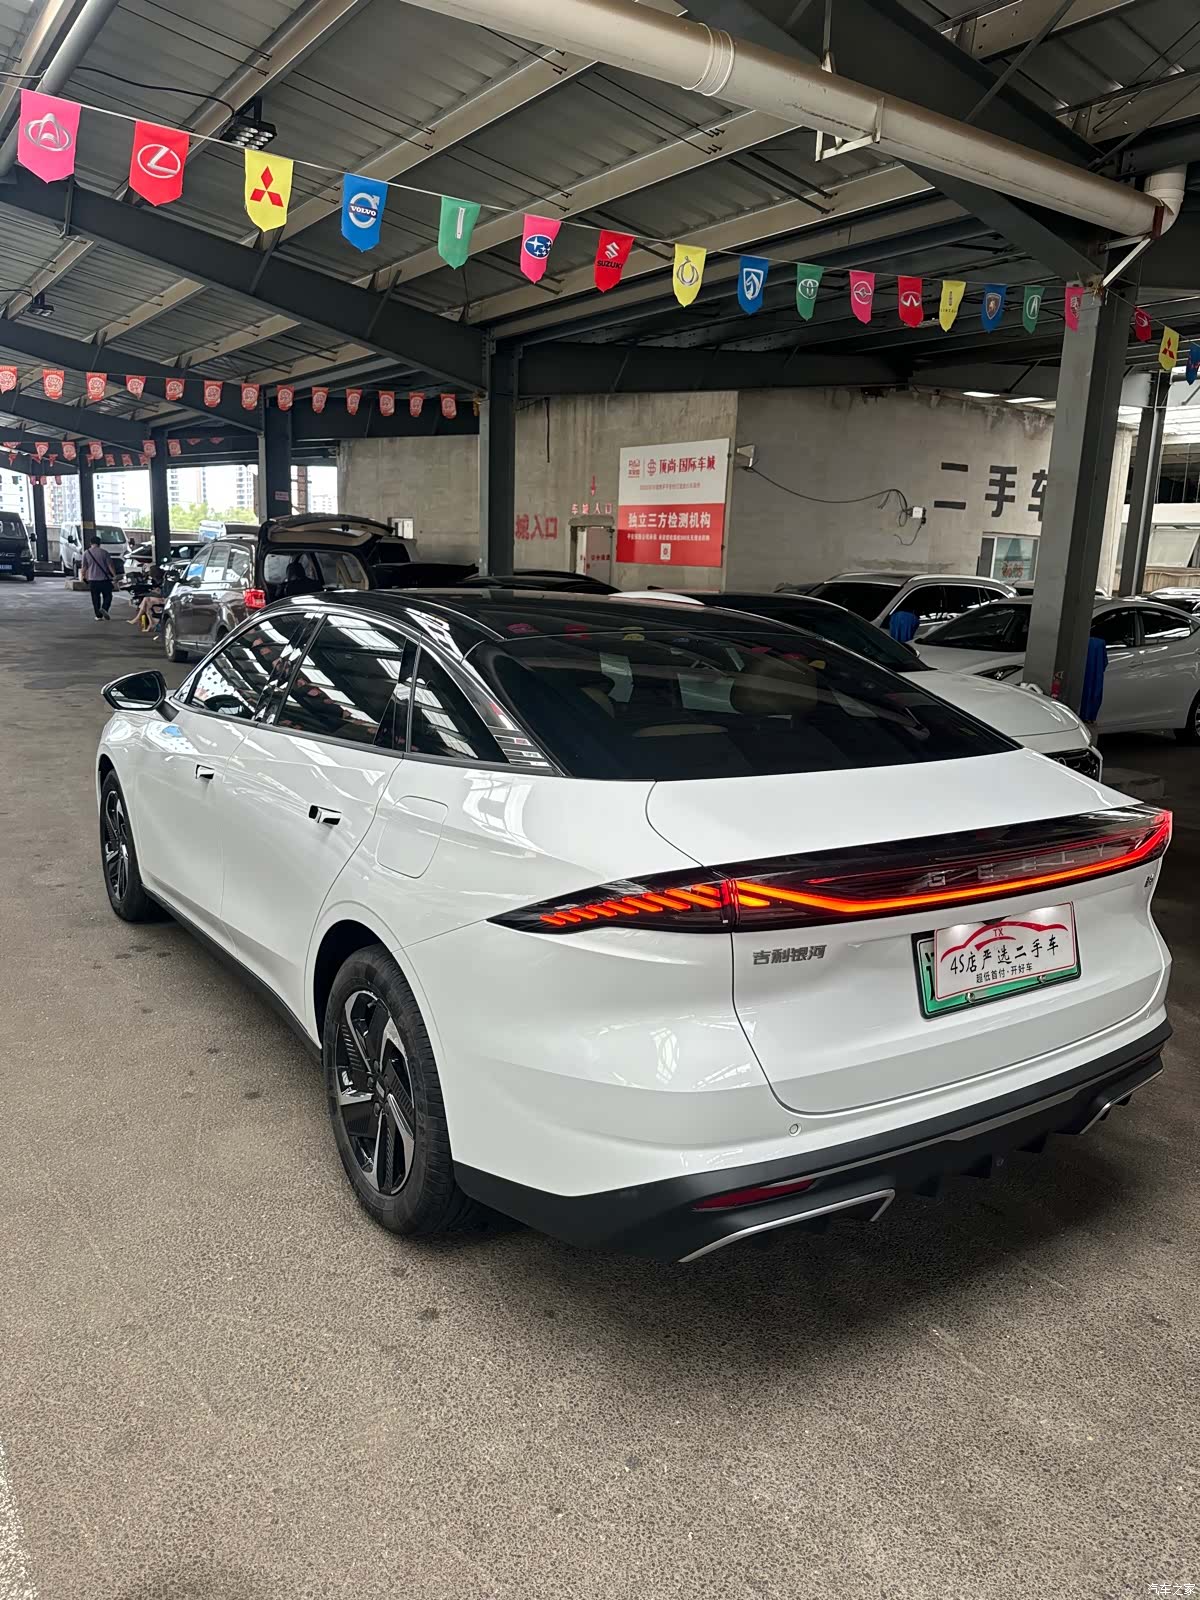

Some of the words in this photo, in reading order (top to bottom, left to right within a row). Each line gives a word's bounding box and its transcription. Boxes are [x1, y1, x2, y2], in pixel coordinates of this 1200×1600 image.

[350, 205, 377, 217] VOLVO
[628, 511, 711, 529] 独立三方检测机构
[993, 927, 1004, 937] TX
[752, 944, 827, 966] 吉利银河
[950, 934, 1060, 975] 4S店严选二手车
